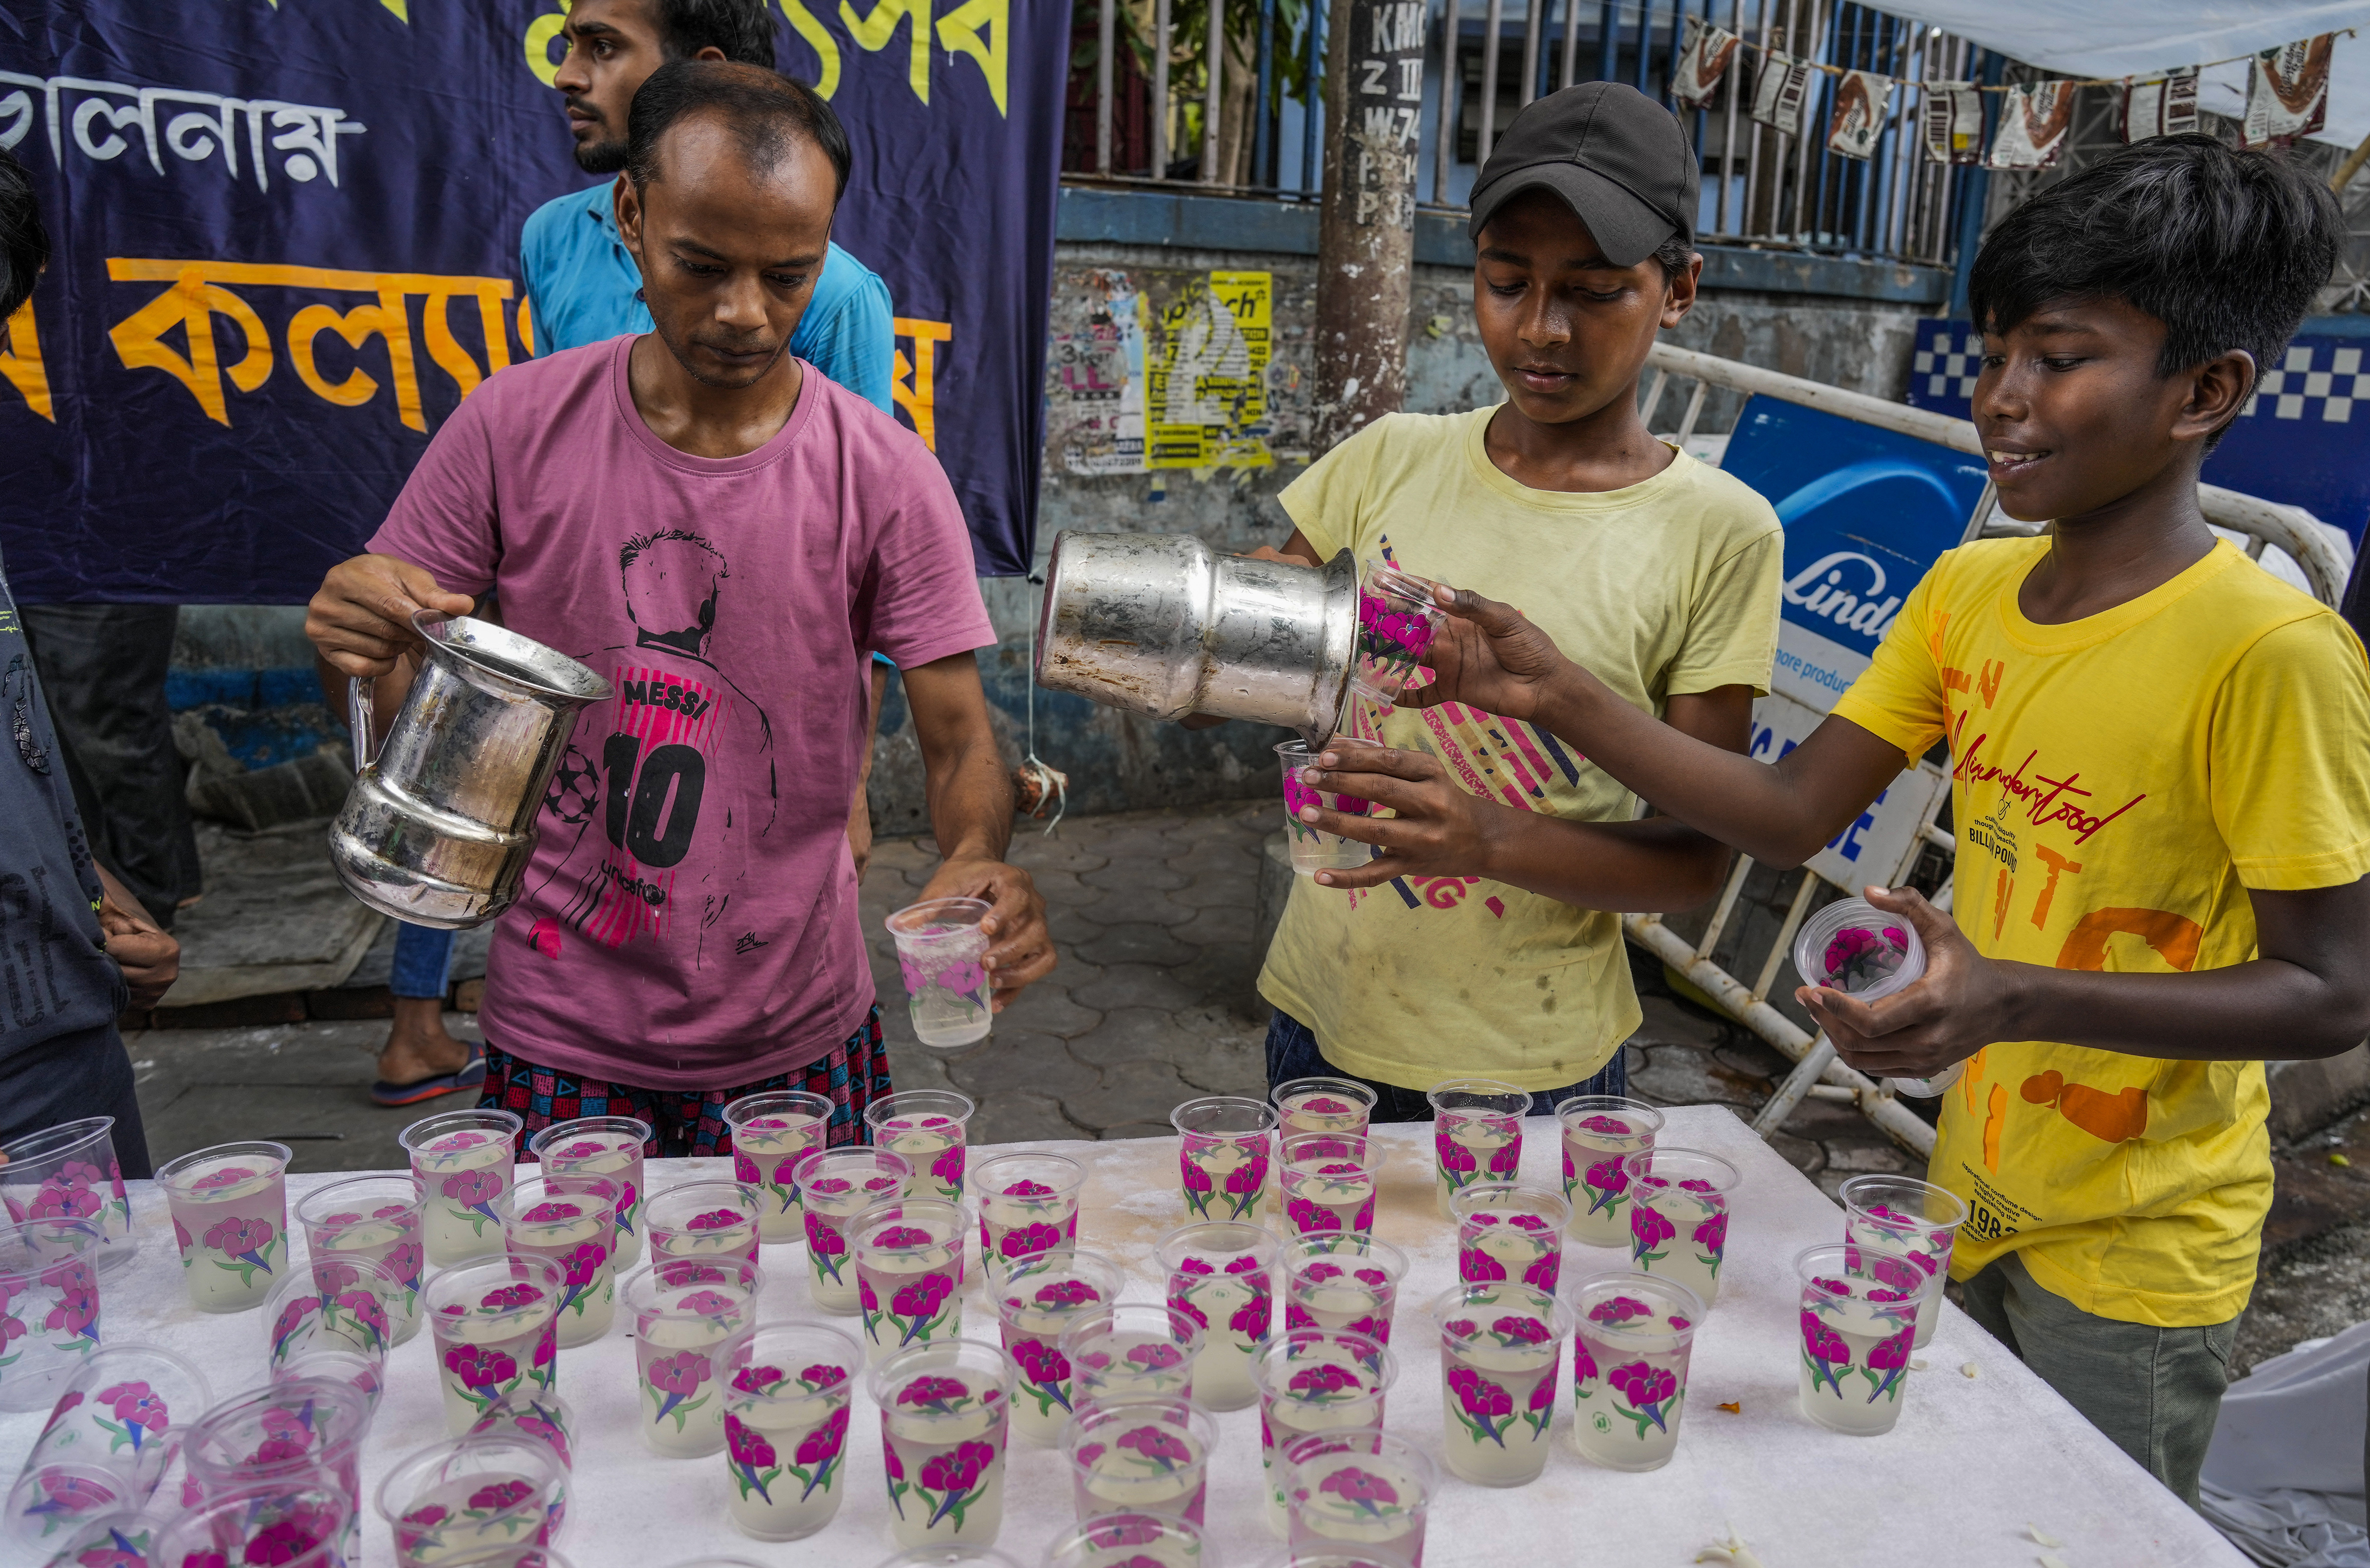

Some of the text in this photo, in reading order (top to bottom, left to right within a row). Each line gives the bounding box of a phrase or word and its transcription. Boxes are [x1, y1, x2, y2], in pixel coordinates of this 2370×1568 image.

[1799, 662, 1855, 695] produc
[623, 680, 711, 720] MESSI
[603, 731, 706, 868] 10
[1994, 844, 2017, 873] POUND
[1974, 1188, 2017, 1223] establishing the
[1979, 1185, 1996, 1201] highly
[1996, 1200, 2020, 1218] creative
[1991, 1188, 2018, 1209] conflume
[2019, 1207, 2043, 1222] design
